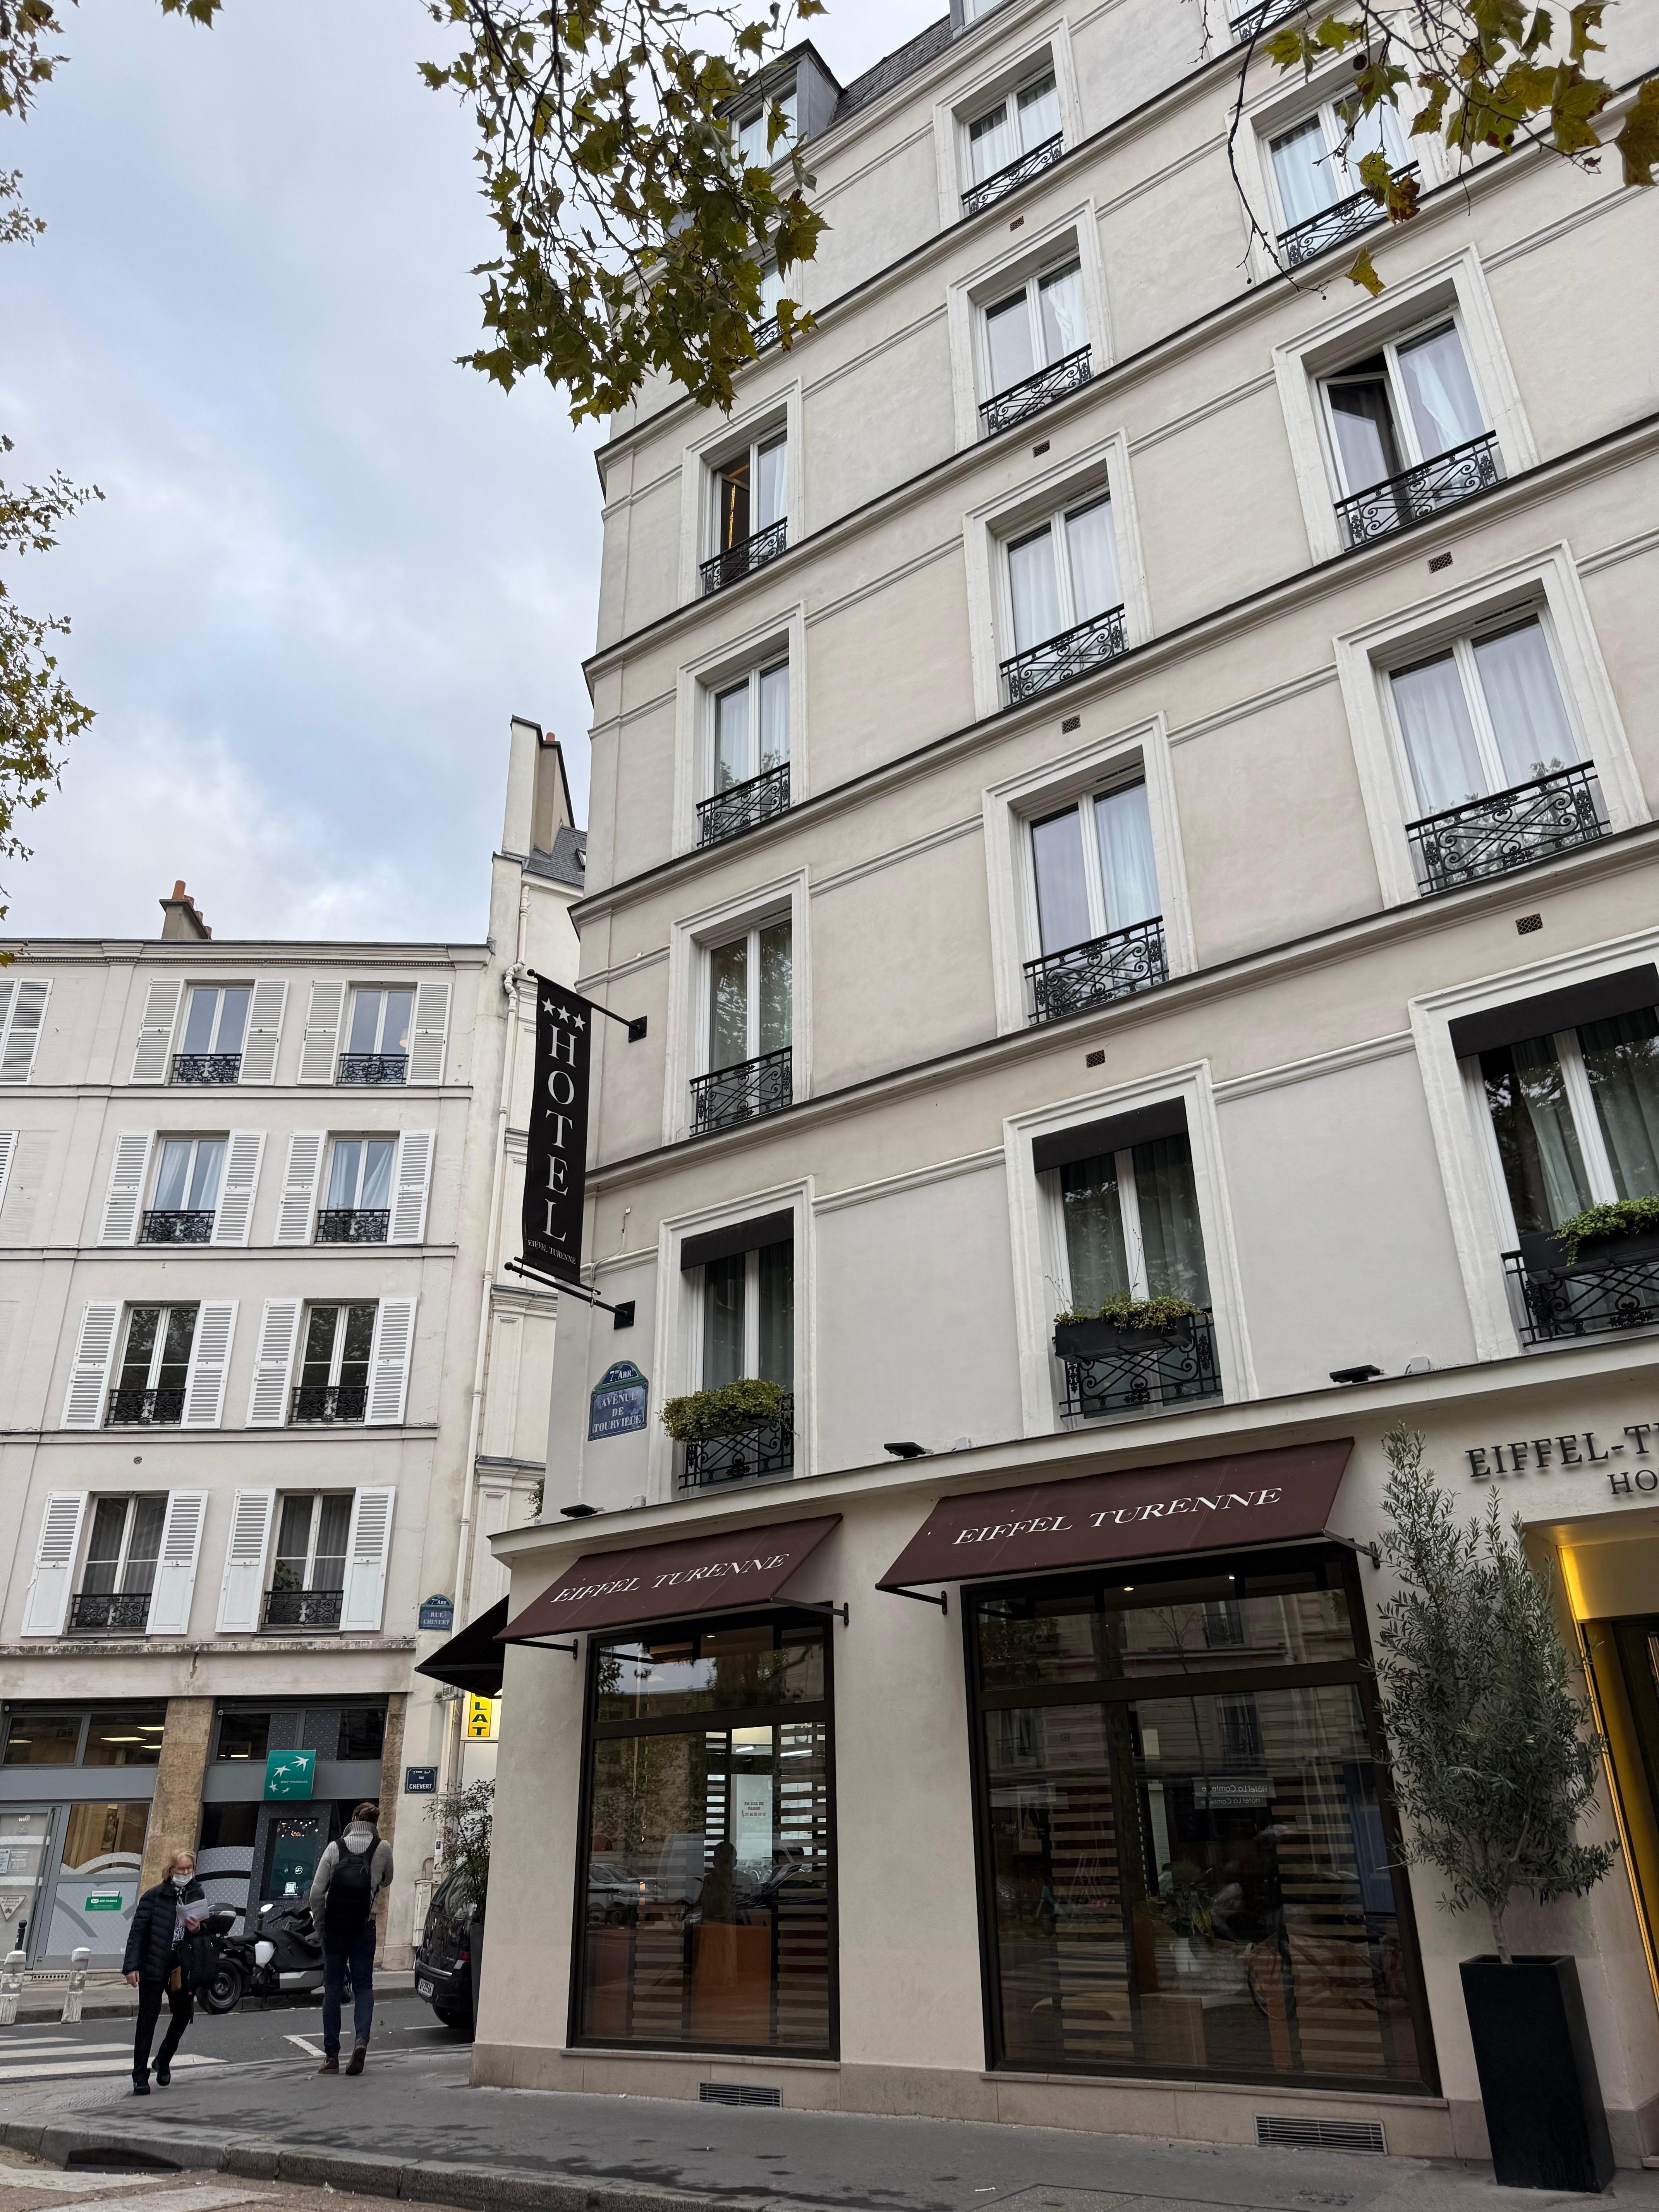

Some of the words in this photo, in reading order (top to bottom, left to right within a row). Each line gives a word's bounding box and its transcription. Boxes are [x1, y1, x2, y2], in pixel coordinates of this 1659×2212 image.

[543, 1024, 577, 1242] HOTEL
[528, 1240, 548, 1252] EIFFEL
[549, 1247, 576, 1264] TURENNE
[601, 1392, 637, 1408] AVENUE
[612, 1407, 624, 1417] DE
[1465, 1423, 1659, 1477] EIFFEL-T
[952, 1516, 1073, 1544] EIFFEL
[1089, 1487, 1283, 1527] TURENNE
[551, 1578, 641, 1602] EIFFEL
[651, 1554, 790, 1588] TURENNE
[471, 1694, 488, 1736] LAT
